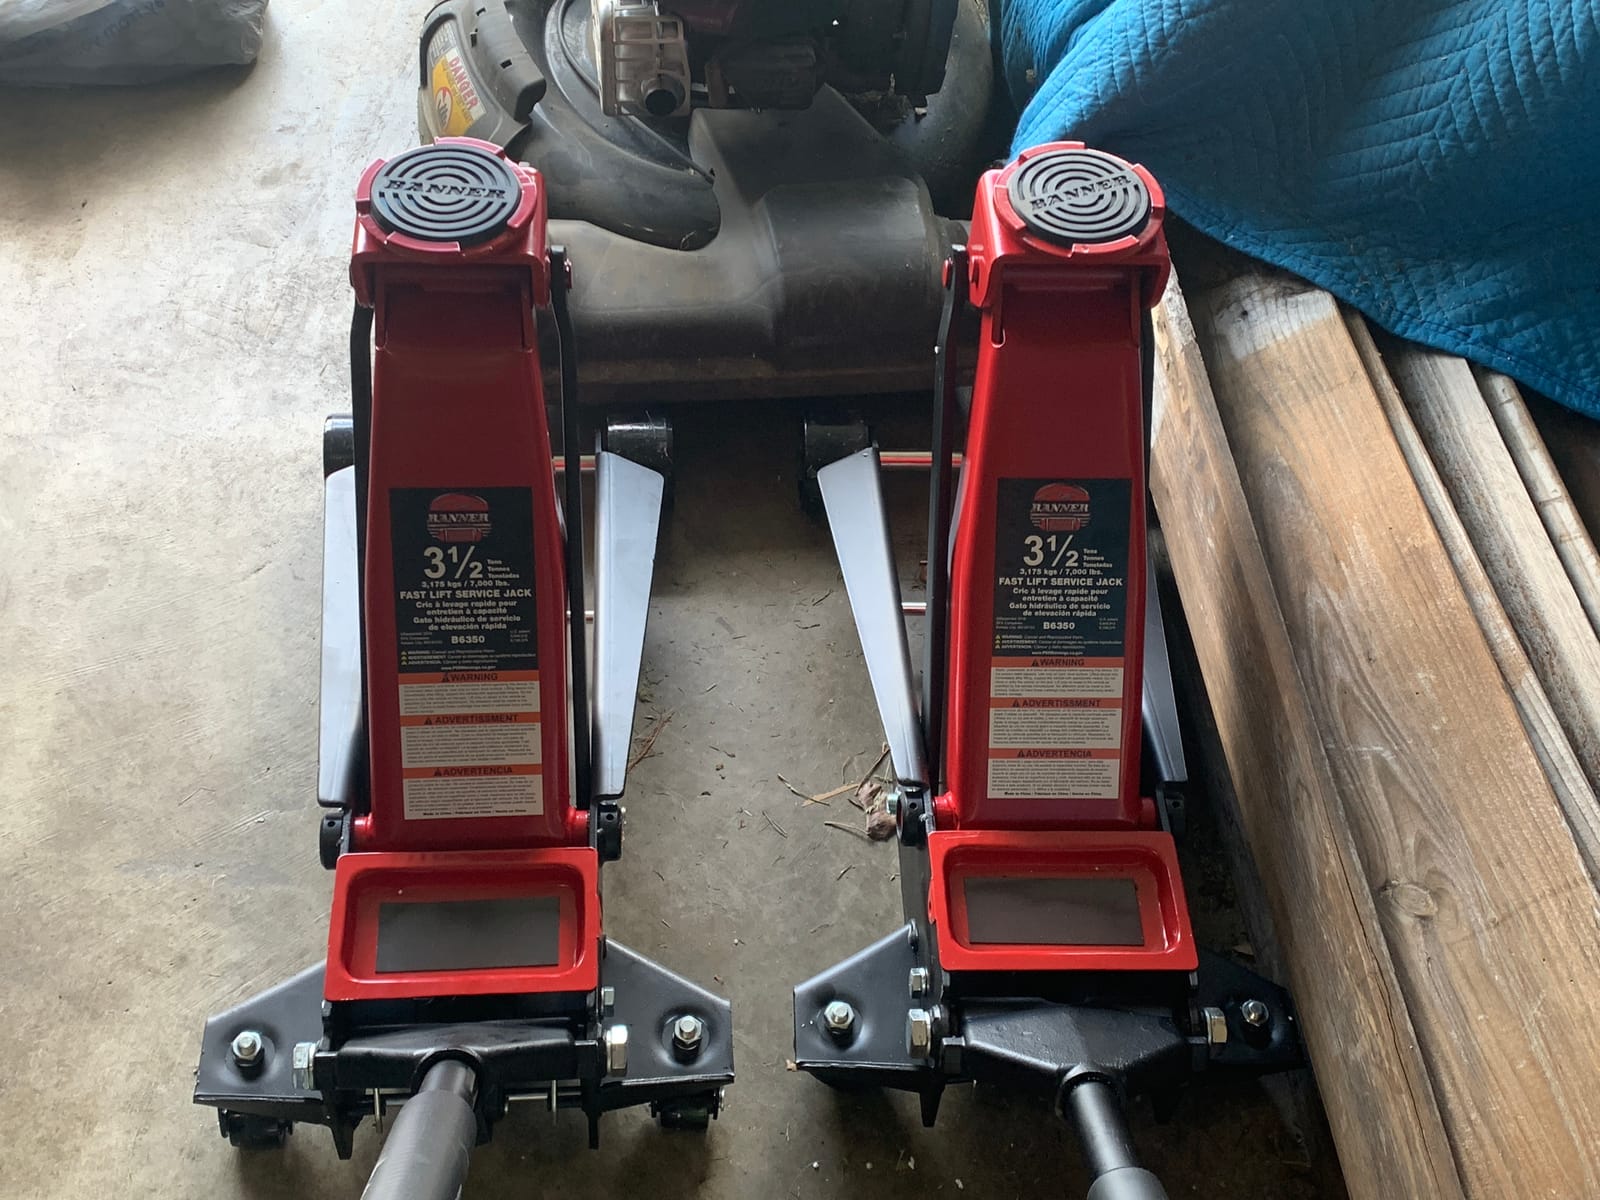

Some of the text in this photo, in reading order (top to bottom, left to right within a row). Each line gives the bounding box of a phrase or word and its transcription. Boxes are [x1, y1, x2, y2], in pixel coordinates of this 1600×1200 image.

[448, 56, 479, 110] DANGER
[999, 577, 1123, 586] FAST LIFT SERVICE JACK
[400, 589, 532, 600] FAST LIFT SERVICE JACK
[1009, 602, 1027, 610] Gato
[1043, 622, 1075, 630] B6350
[451, 636, 485, 644] B6350
[1040, 658, 1085, 667] WARNING
[451, 673, 498, 682] WARNING
[1026, 750, 1092, 758] ADVERTENCIA
[441, 767, 512, 776] ADVERTENCIA
